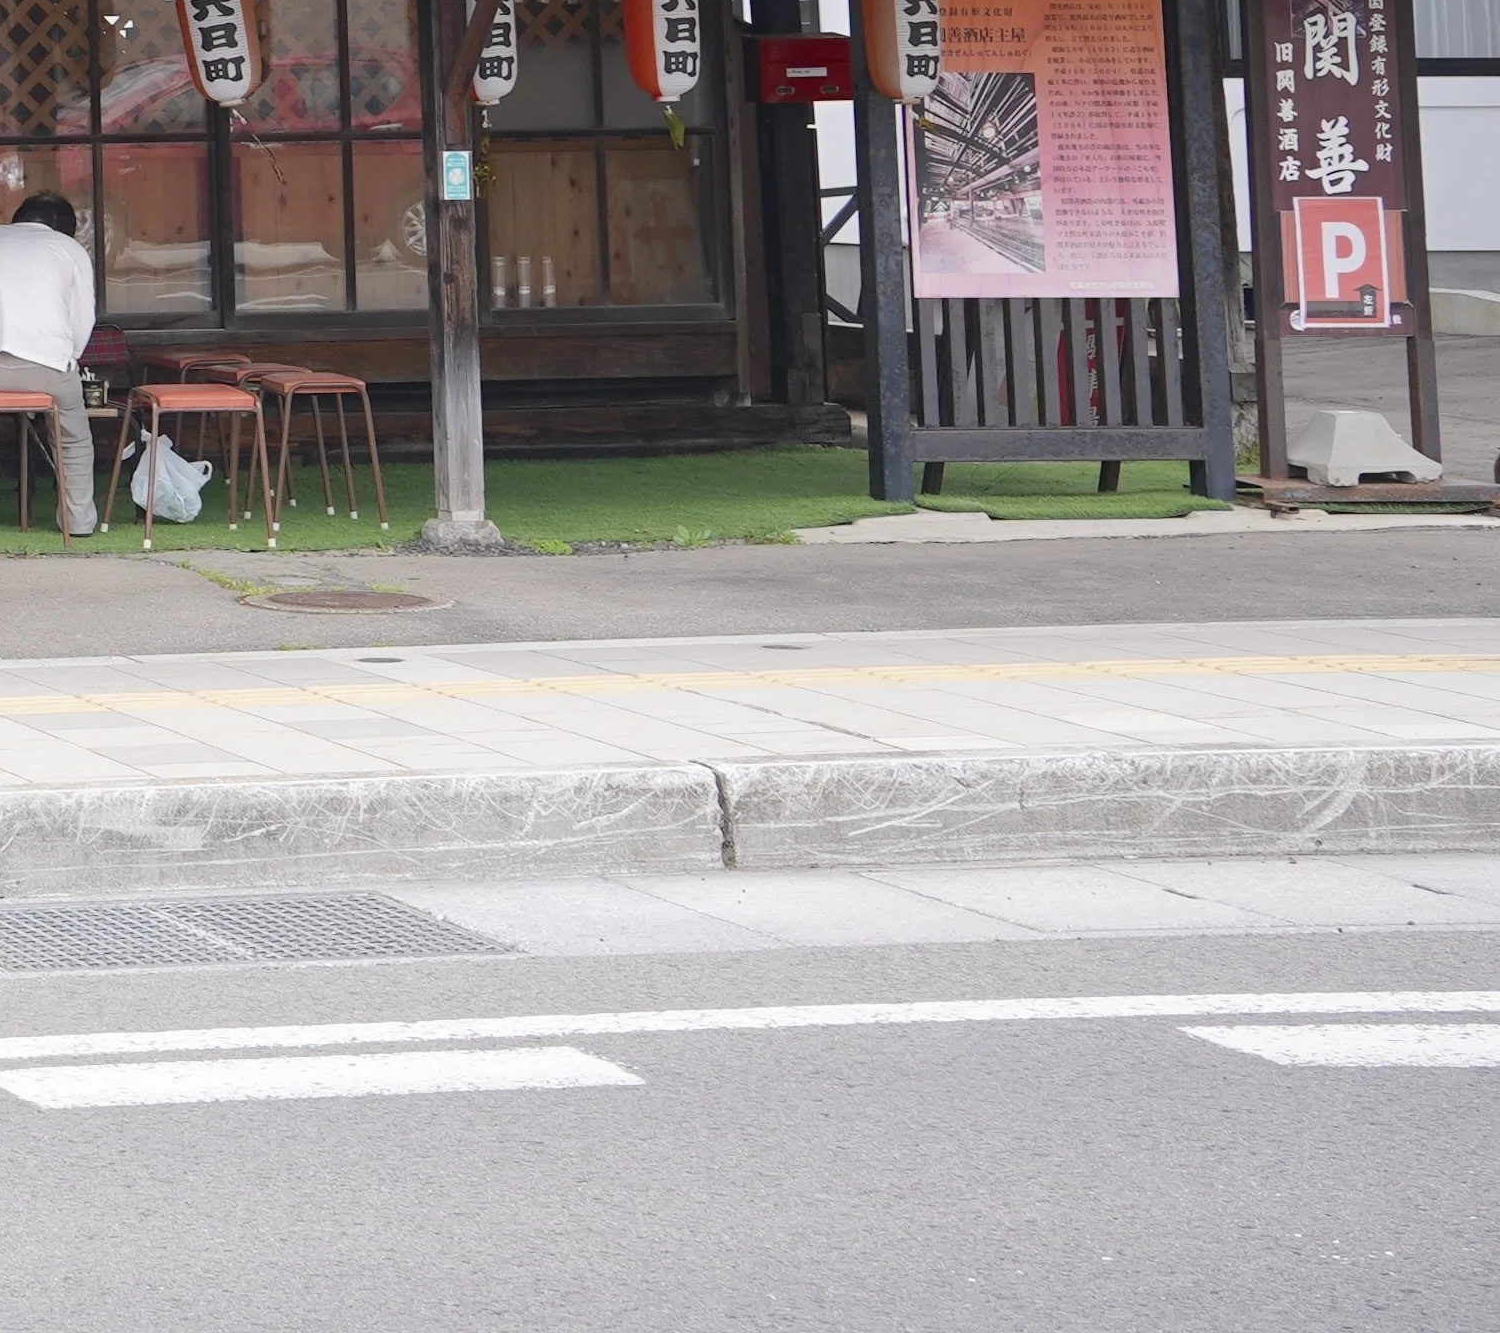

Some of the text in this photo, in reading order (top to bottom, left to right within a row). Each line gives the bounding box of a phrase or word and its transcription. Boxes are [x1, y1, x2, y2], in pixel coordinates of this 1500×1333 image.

[1274, 41, 1302, 182] 旧関善酒店
[1303, 11, 1370, 196] 関善
[1320, 220, 1368, 299] P
